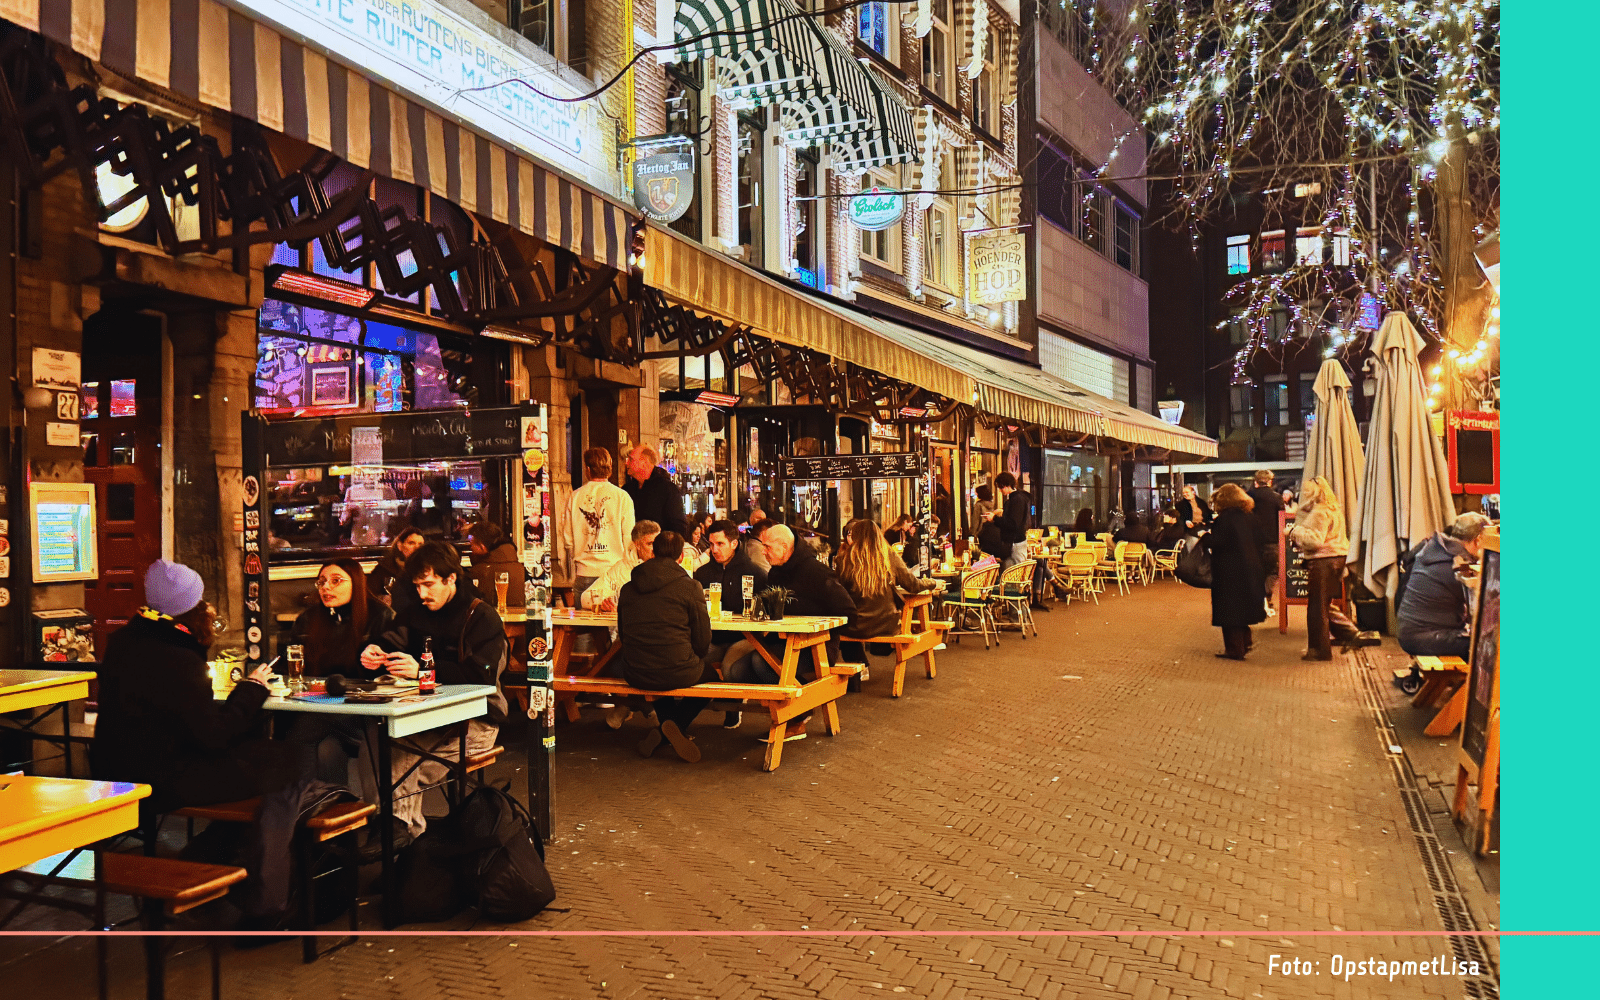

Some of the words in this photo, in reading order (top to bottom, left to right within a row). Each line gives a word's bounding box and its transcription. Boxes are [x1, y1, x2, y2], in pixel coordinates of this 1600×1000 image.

[366, 9, 443, 75] RUITER
[462, 62, 570, 142] MAASTRICHT
[636, 162, 669, 178] Hertog
[670, 160, 690, 175] Jan
[853, 195, 897, 217] Grolsch
[973, 251, 1022, 270] HOENDER
[974, 268, 1021, 292] HOP
[59, 394, 77, 418] 27
